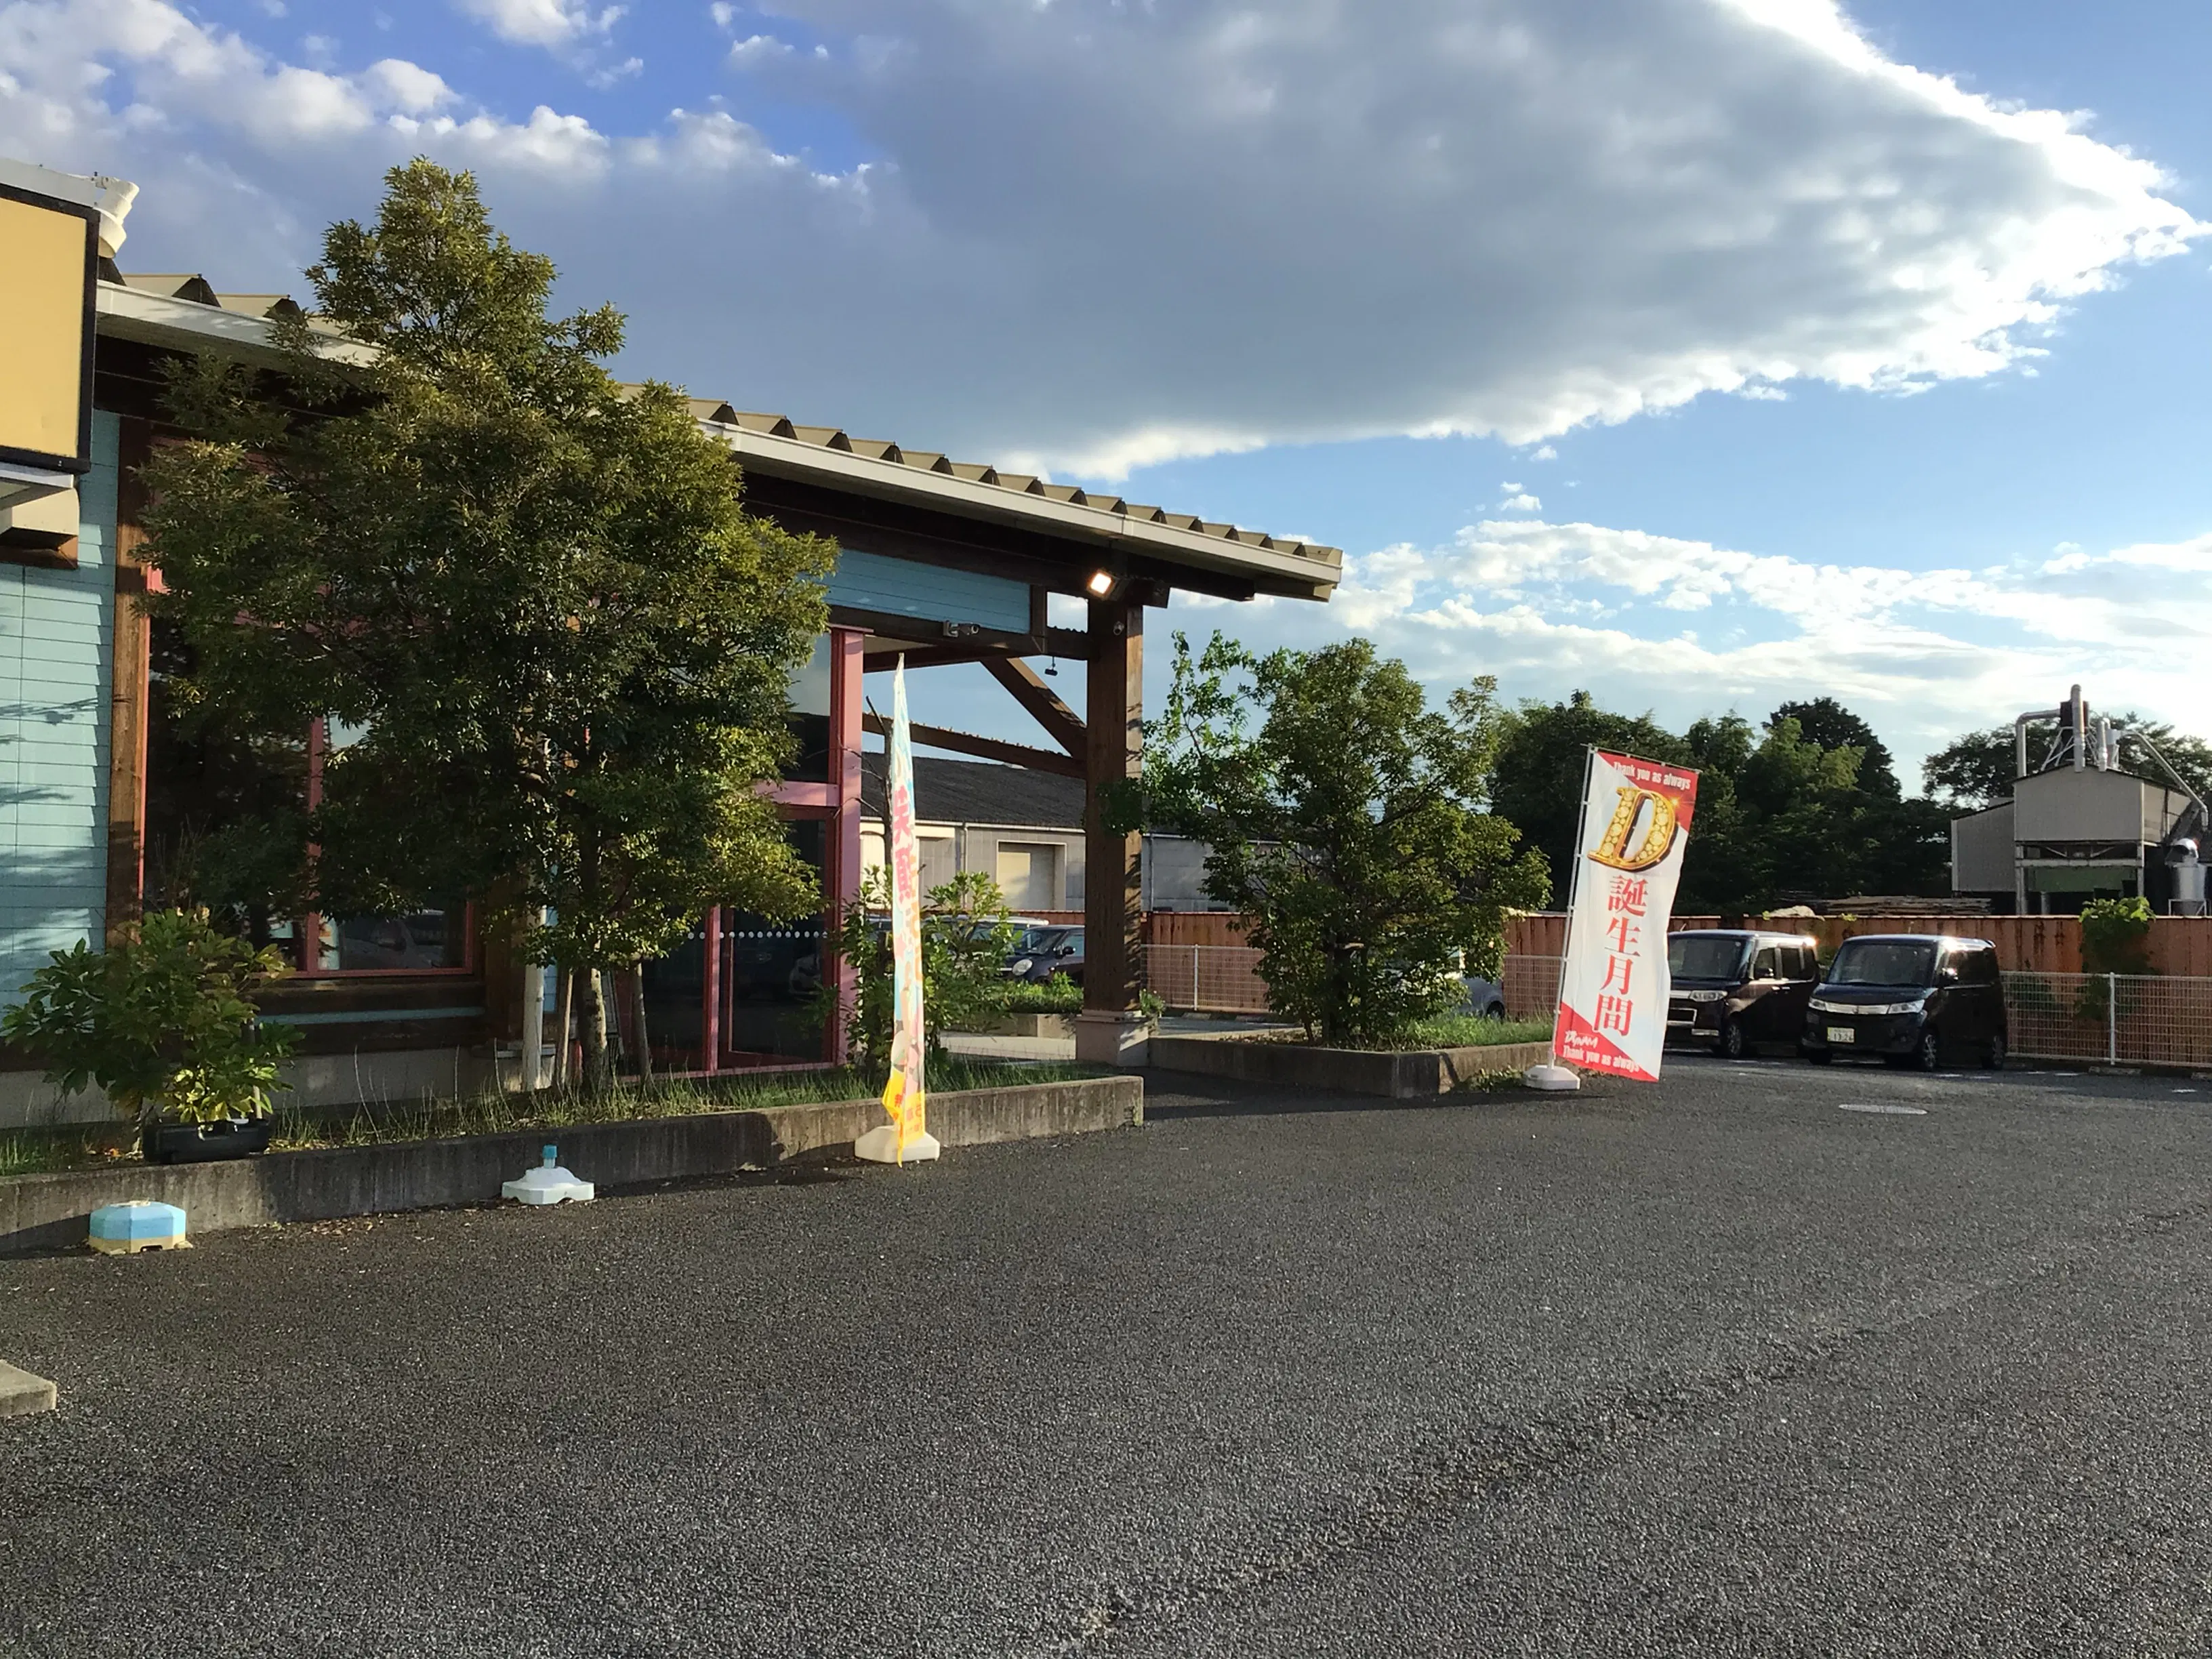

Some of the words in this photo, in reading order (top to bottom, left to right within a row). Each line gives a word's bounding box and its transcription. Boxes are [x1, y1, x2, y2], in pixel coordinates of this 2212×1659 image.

[1614, 762, 1635, 777] Thank
[1637, 768, 1651, 781] you
[1652, 772, 1662, 783] as
[1664, 773, 1691, 790] always
[1587, 786, 1676, 870] D
[1594, 875, 1648, 1036] 誕生月間
[1563, 1044, 1584, 1061] Thank
[1585, 1050, 1601, 1064] you
[1601, 1054, 1612, 1066] as
[1613, 1055, 1641, 1073] always
